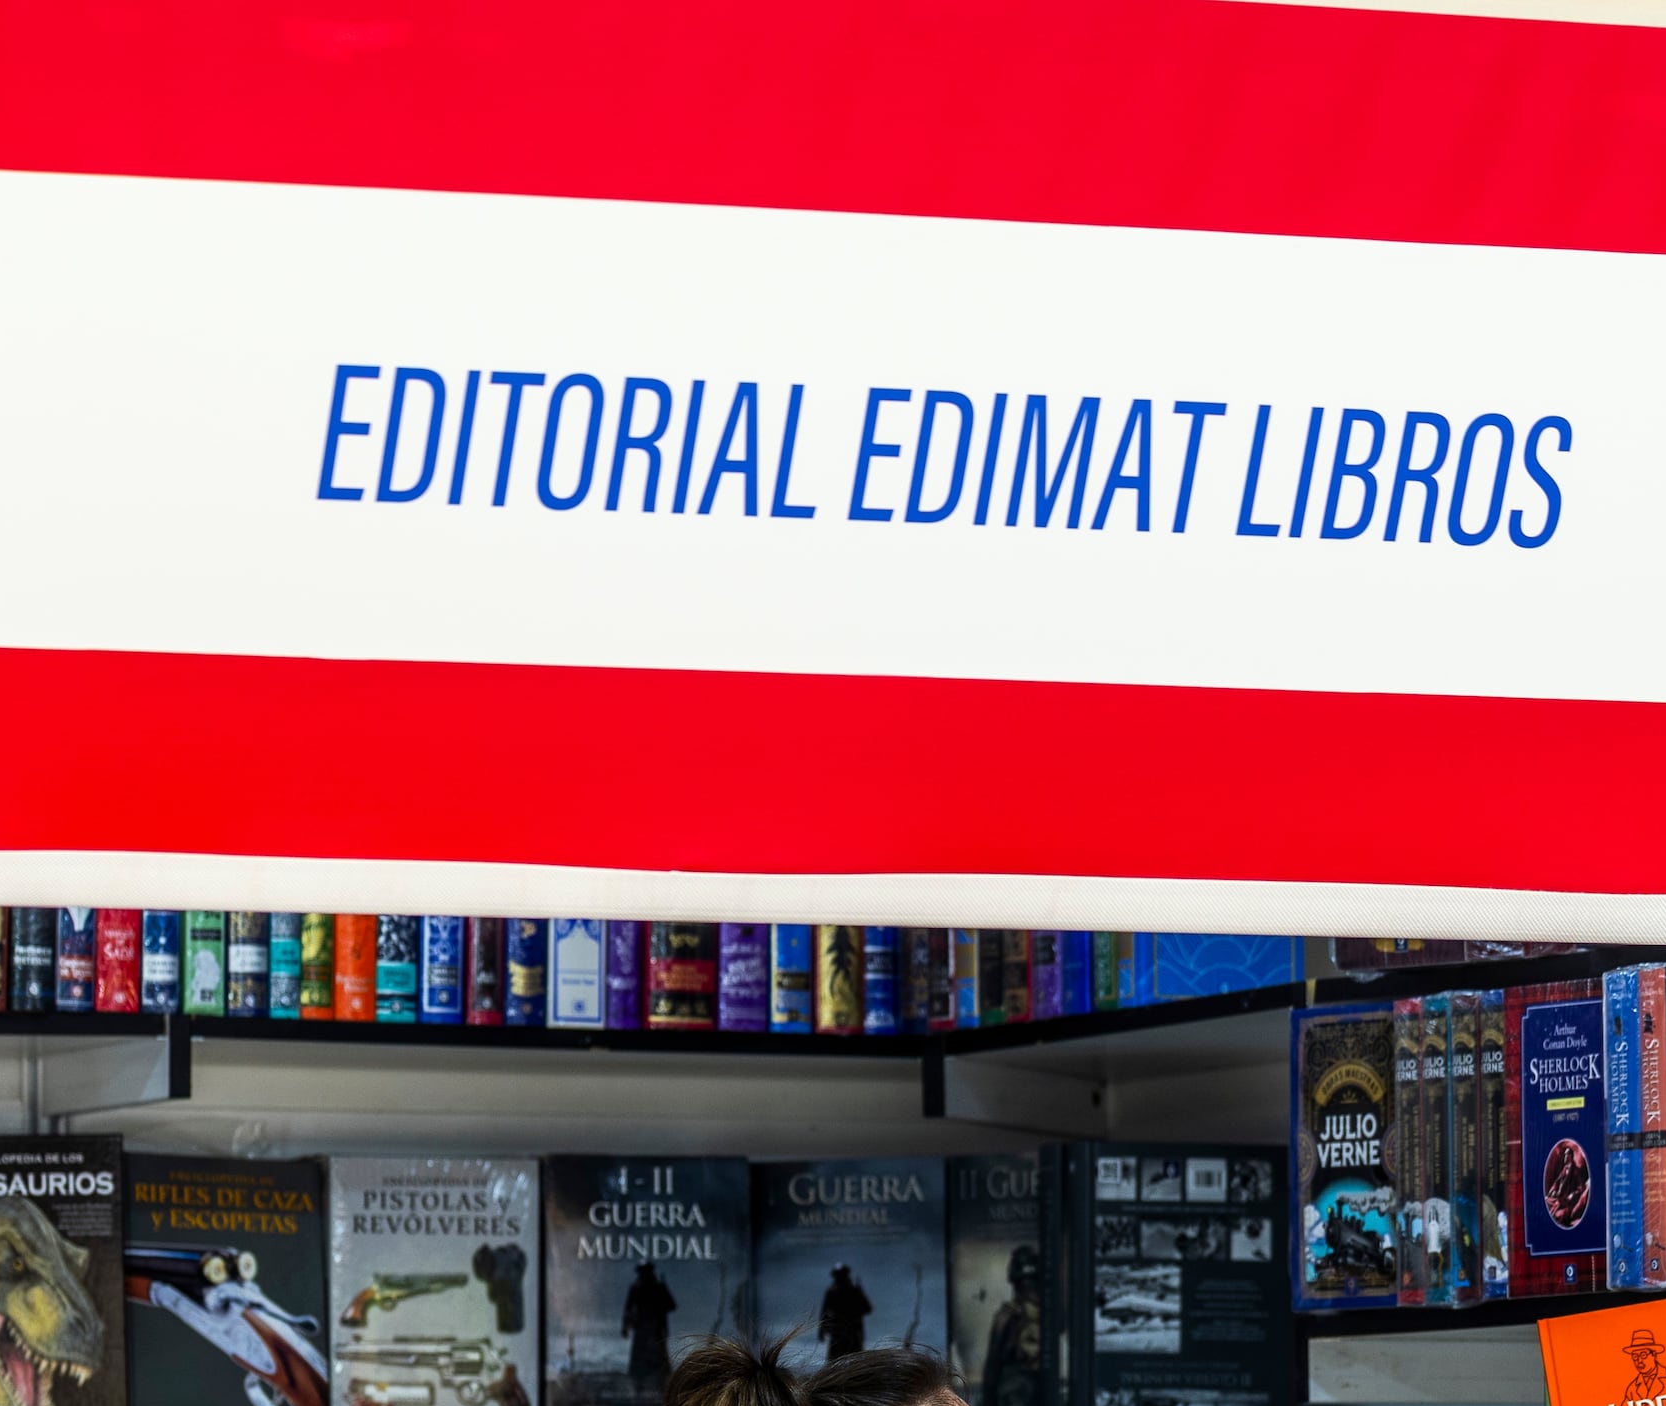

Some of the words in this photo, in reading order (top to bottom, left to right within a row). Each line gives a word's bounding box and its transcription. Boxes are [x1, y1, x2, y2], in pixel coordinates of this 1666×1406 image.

[316, 365, 816, 521] EDITORIAL
[848, 386, 1226, 535] EDIMAT
[1236, 404, 1573, 552] LIBROS
[1553, 1024, 1576, 1035] Arthur
[1543, 1039, 1564, 1050] Conan
[1567, 1037, 1587, 1048] Doyle
[1529, 1053, 1600, 1084] SHERLOCK
[1539, 1074, 1588, 1093] HOLMES
[1320, 1114, 1377, 1141] JULIO
[1317, 1142, 1380, 1168] VERNE
[135, 1183, 211, 1209] RIFLES
[217, 1187, 248, 1210] DE
[254, 1187, 314, 1212] CAZA
[362, 1191, 486, 1212] PISTOLAS
[788, 1171, 924, 1206] GUERRA
[151, 1212, 161, 1232] y
[169, 1211, 297, 1234] ESCOPETAS
[352, 1209, 520, 1236] REVÓLVERES
[589, 1201, 706, 1228] GUERRA
[577, 1234, 716, 1261] MUNDIAL
